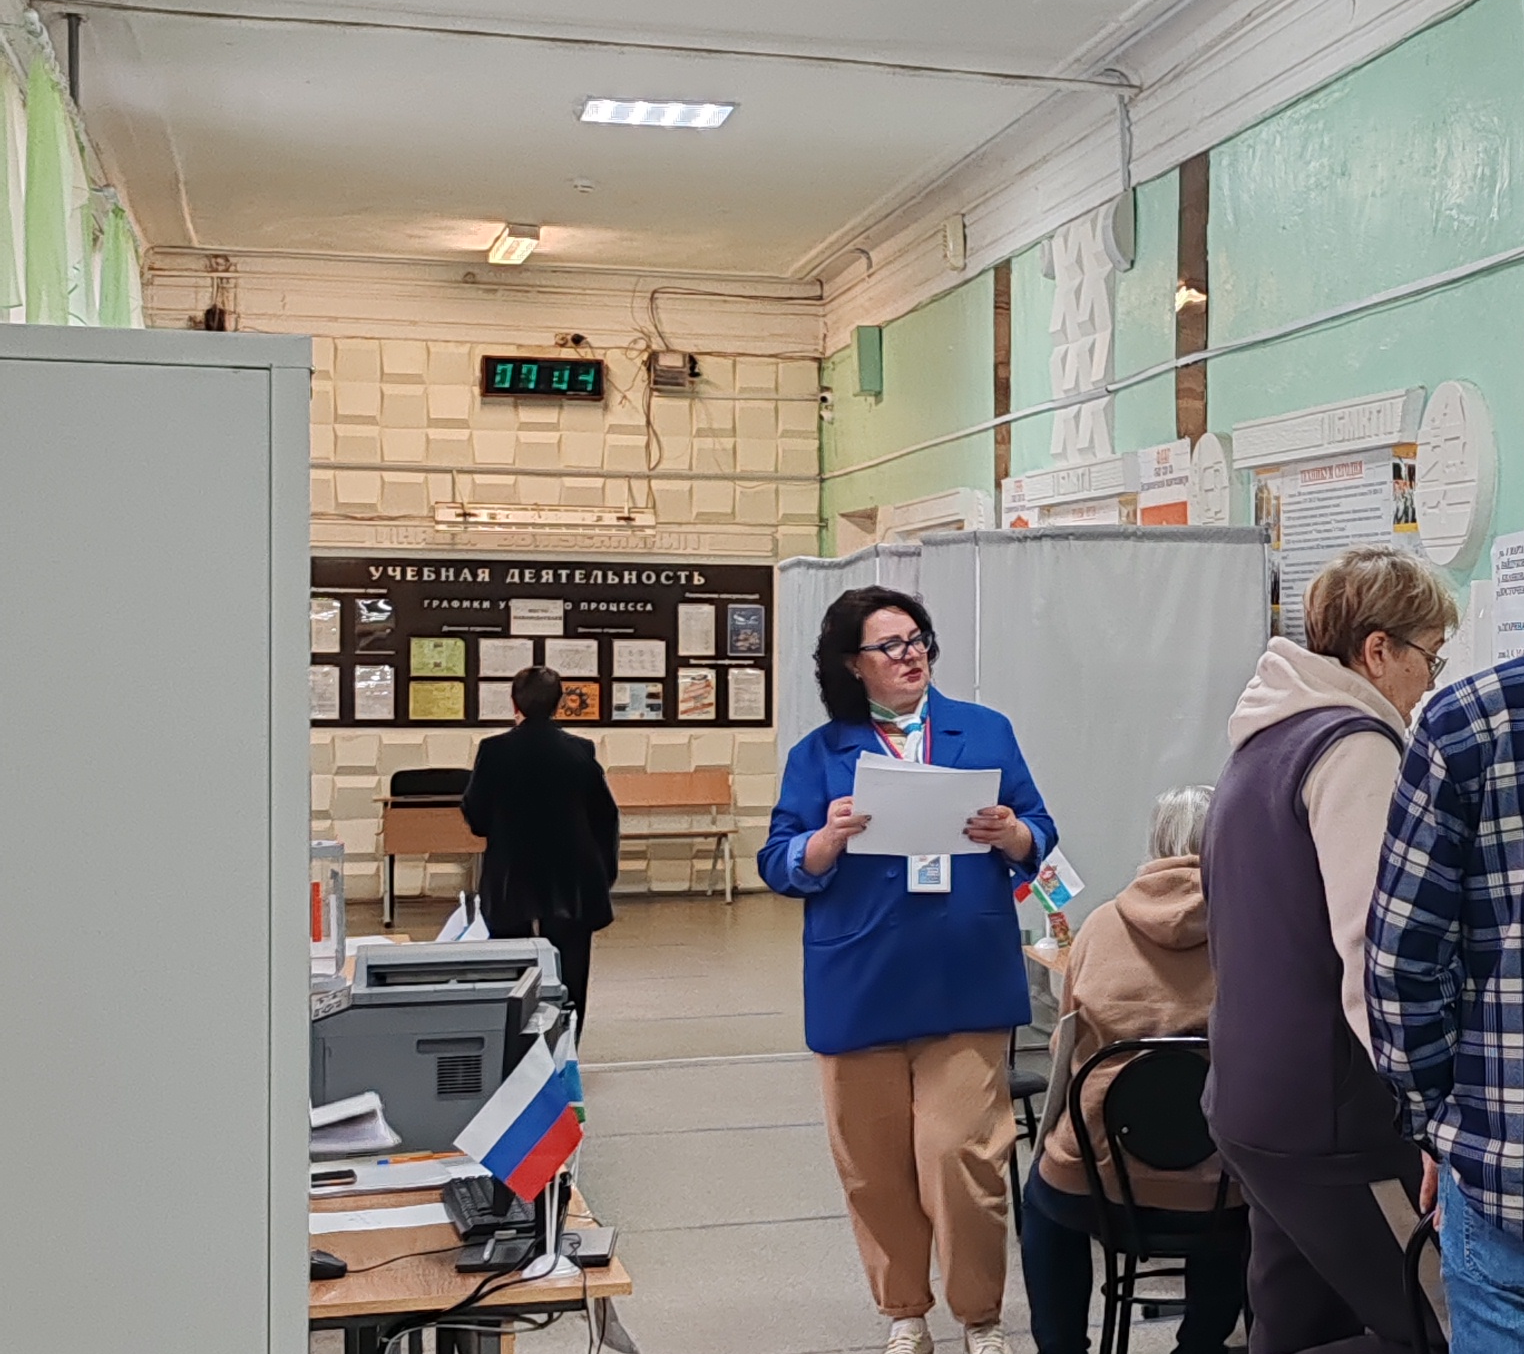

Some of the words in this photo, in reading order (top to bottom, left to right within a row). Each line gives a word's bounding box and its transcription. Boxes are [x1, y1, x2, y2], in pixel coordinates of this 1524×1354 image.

[369, 565, 491, 582] УЧЕБНАЯ
[506, 568, 706, 585] ДЕЯТЕЛЬНОСТЬ
[423, 600, 491, 609] ГРАФИКИ
[580, 602, 653, 612] ПРОЦЕССА
